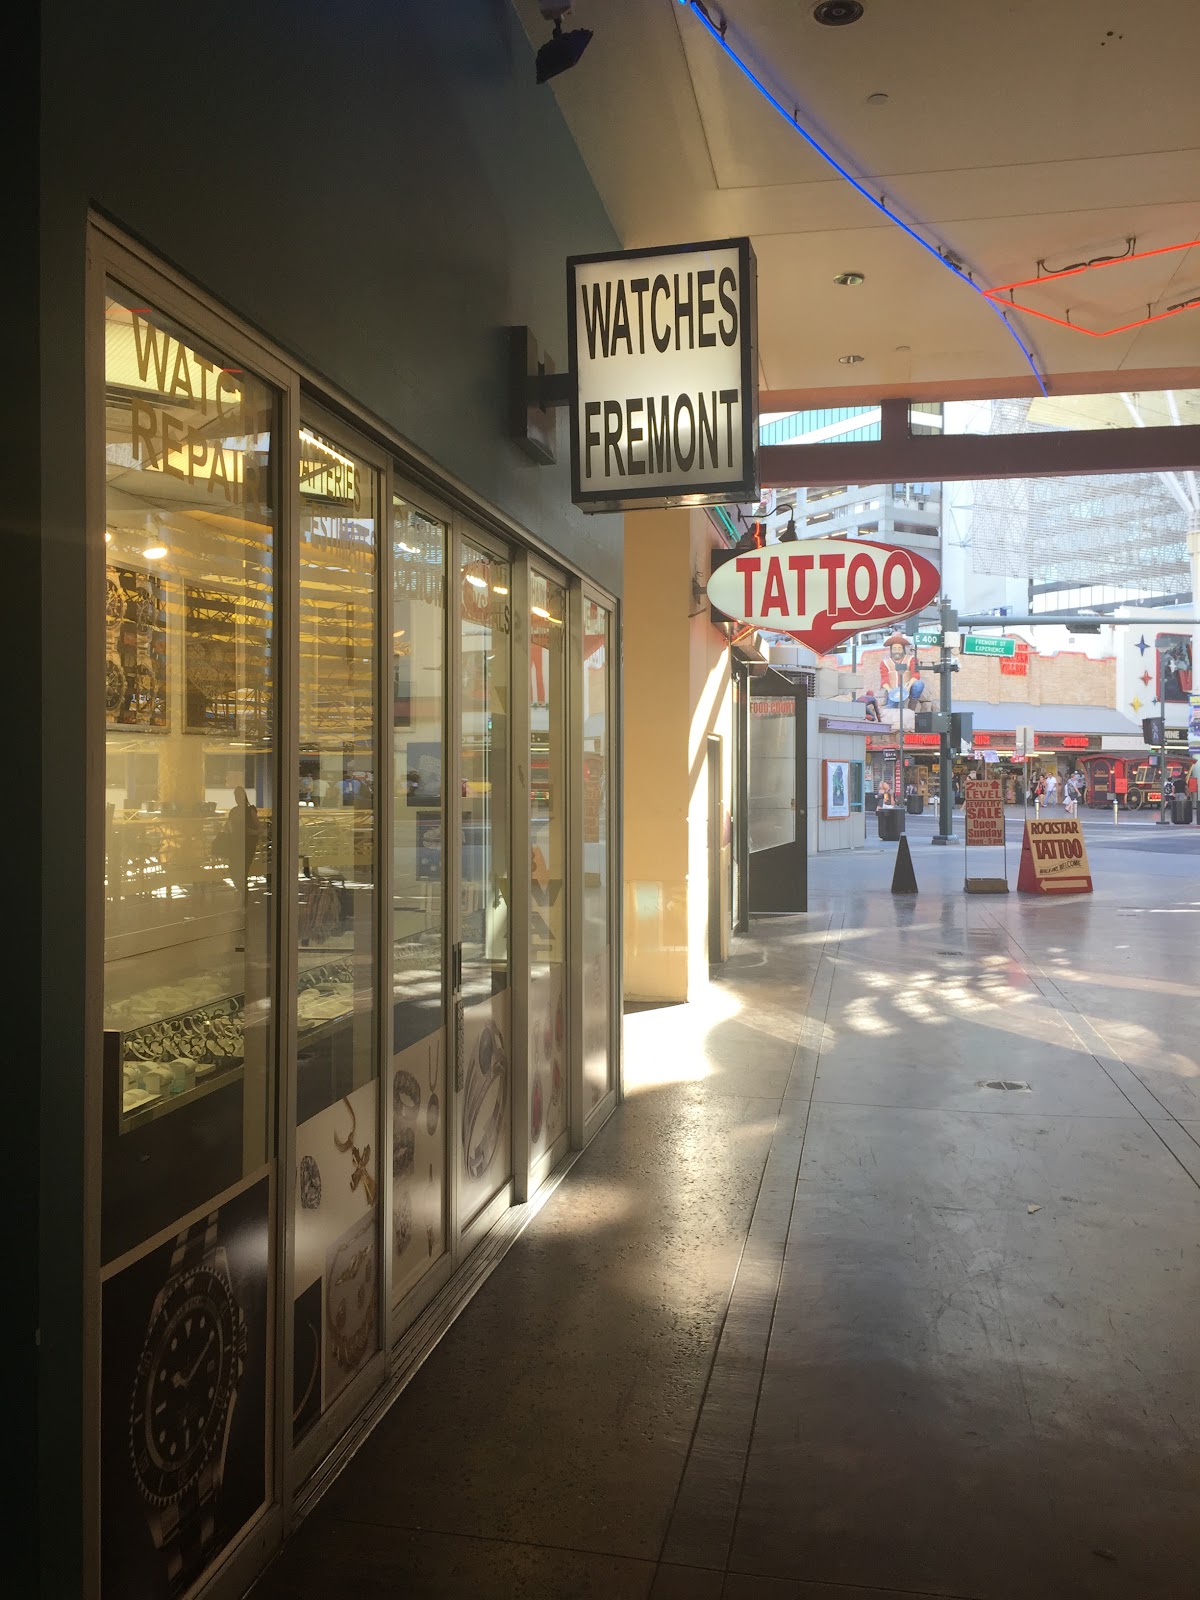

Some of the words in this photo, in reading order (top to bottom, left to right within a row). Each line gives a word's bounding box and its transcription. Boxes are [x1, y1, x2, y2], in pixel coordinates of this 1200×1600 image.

[581, 266, 738, 360] WATCHES
[585, 389, 739, 478] FREMONT
[735, 551, 914, 617] TATTOO
[915, 635, 920, 643] E
[922, 635, 938, 643] 400
[975, 639, 997, 647] FREMONT
[975, 646, 1005, 654] EXPERIENCE
[750, 702, 768, 714] FOOD
[771, 701, 795, 714] COURT
[966, 781, 989, 791] 2ND
[966, 790, 1002, 799] LEVEL
[967, 808, 1002, 819] SALE
[973, 820, 996, 830] Open
[1031, 821, 1079, 835] ROCKSTAR
[968, 829, 1003, 838] Sunday
[1032, 838, 1084, 860] TATTOO
[1059, 859, 1082, 871] WELCOME
